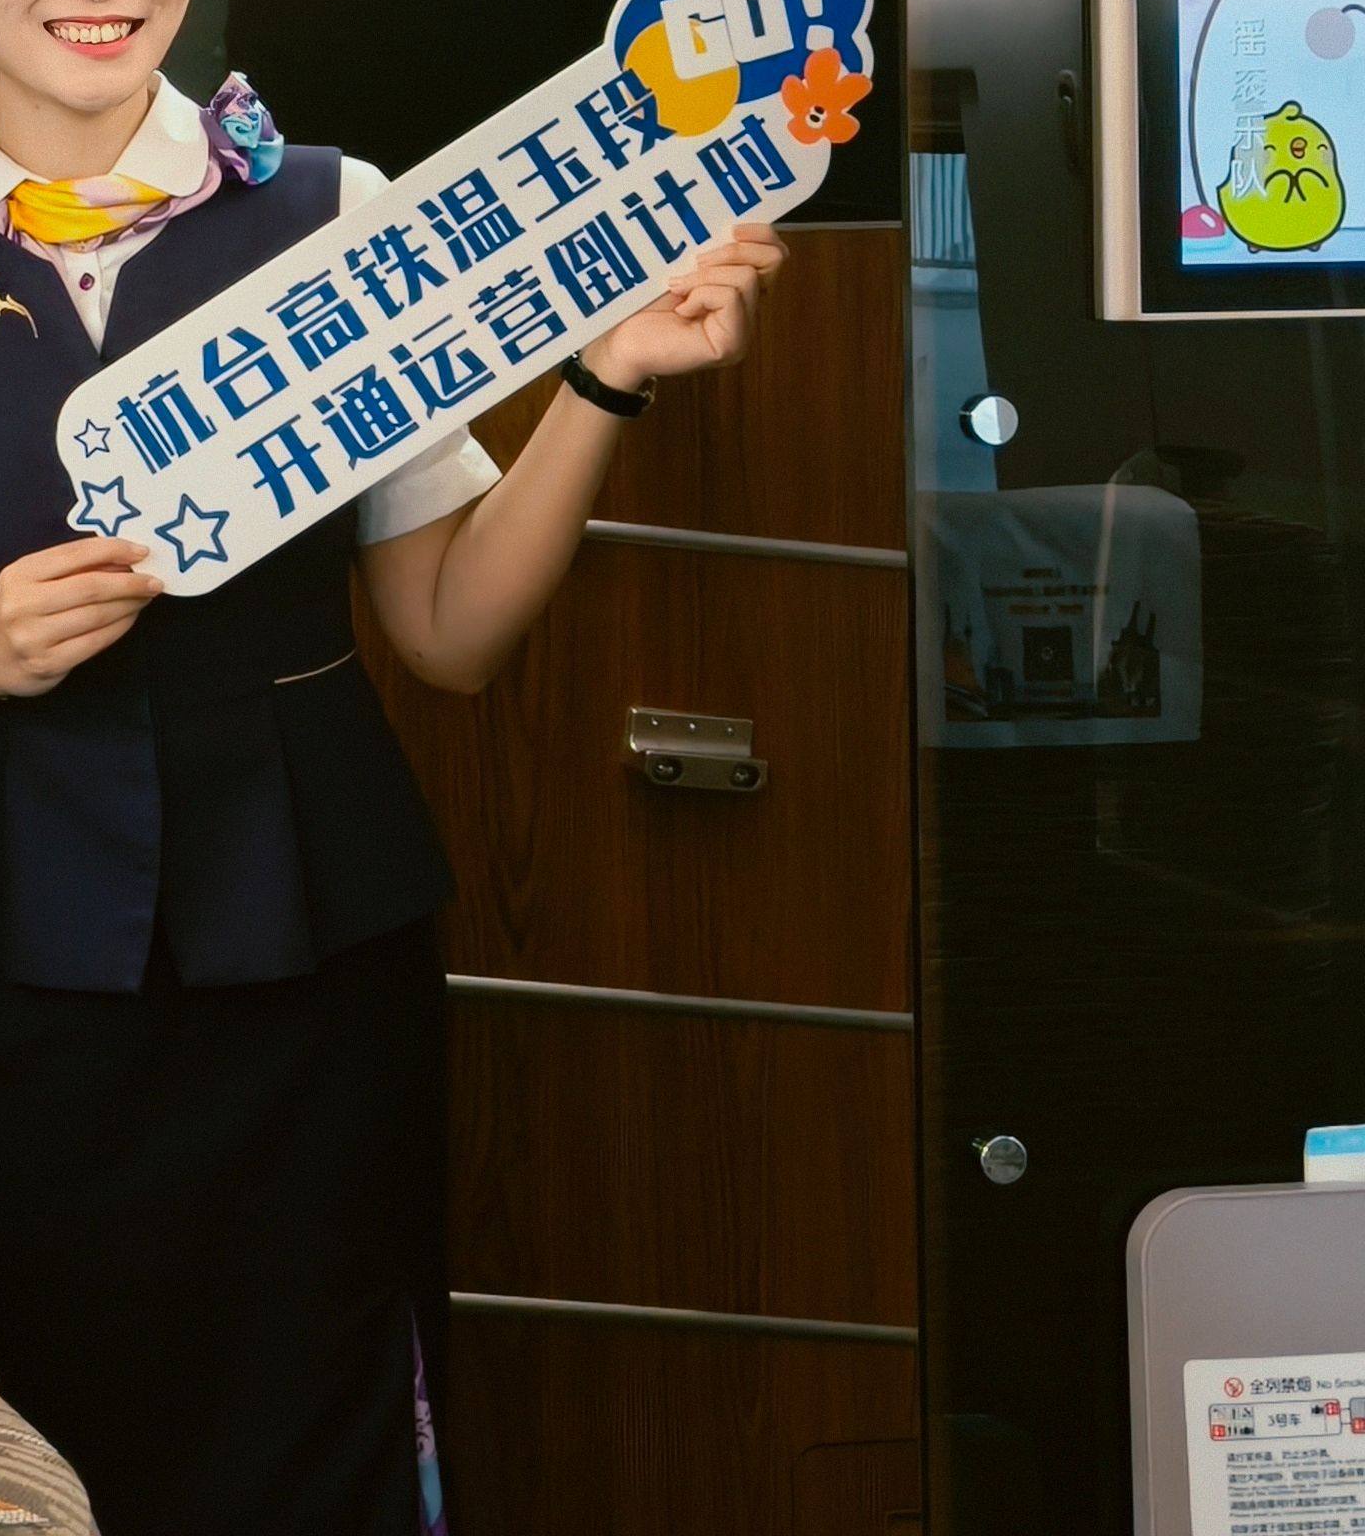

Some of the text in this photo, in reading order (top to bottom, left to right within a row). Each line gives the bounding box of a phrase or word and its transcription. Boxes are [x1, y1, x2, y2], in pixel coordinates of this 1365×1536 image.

[114, 67, 677, 474] 杭台高铁温玉段
[235, 116, 797, 518] 开通运营倒计时
